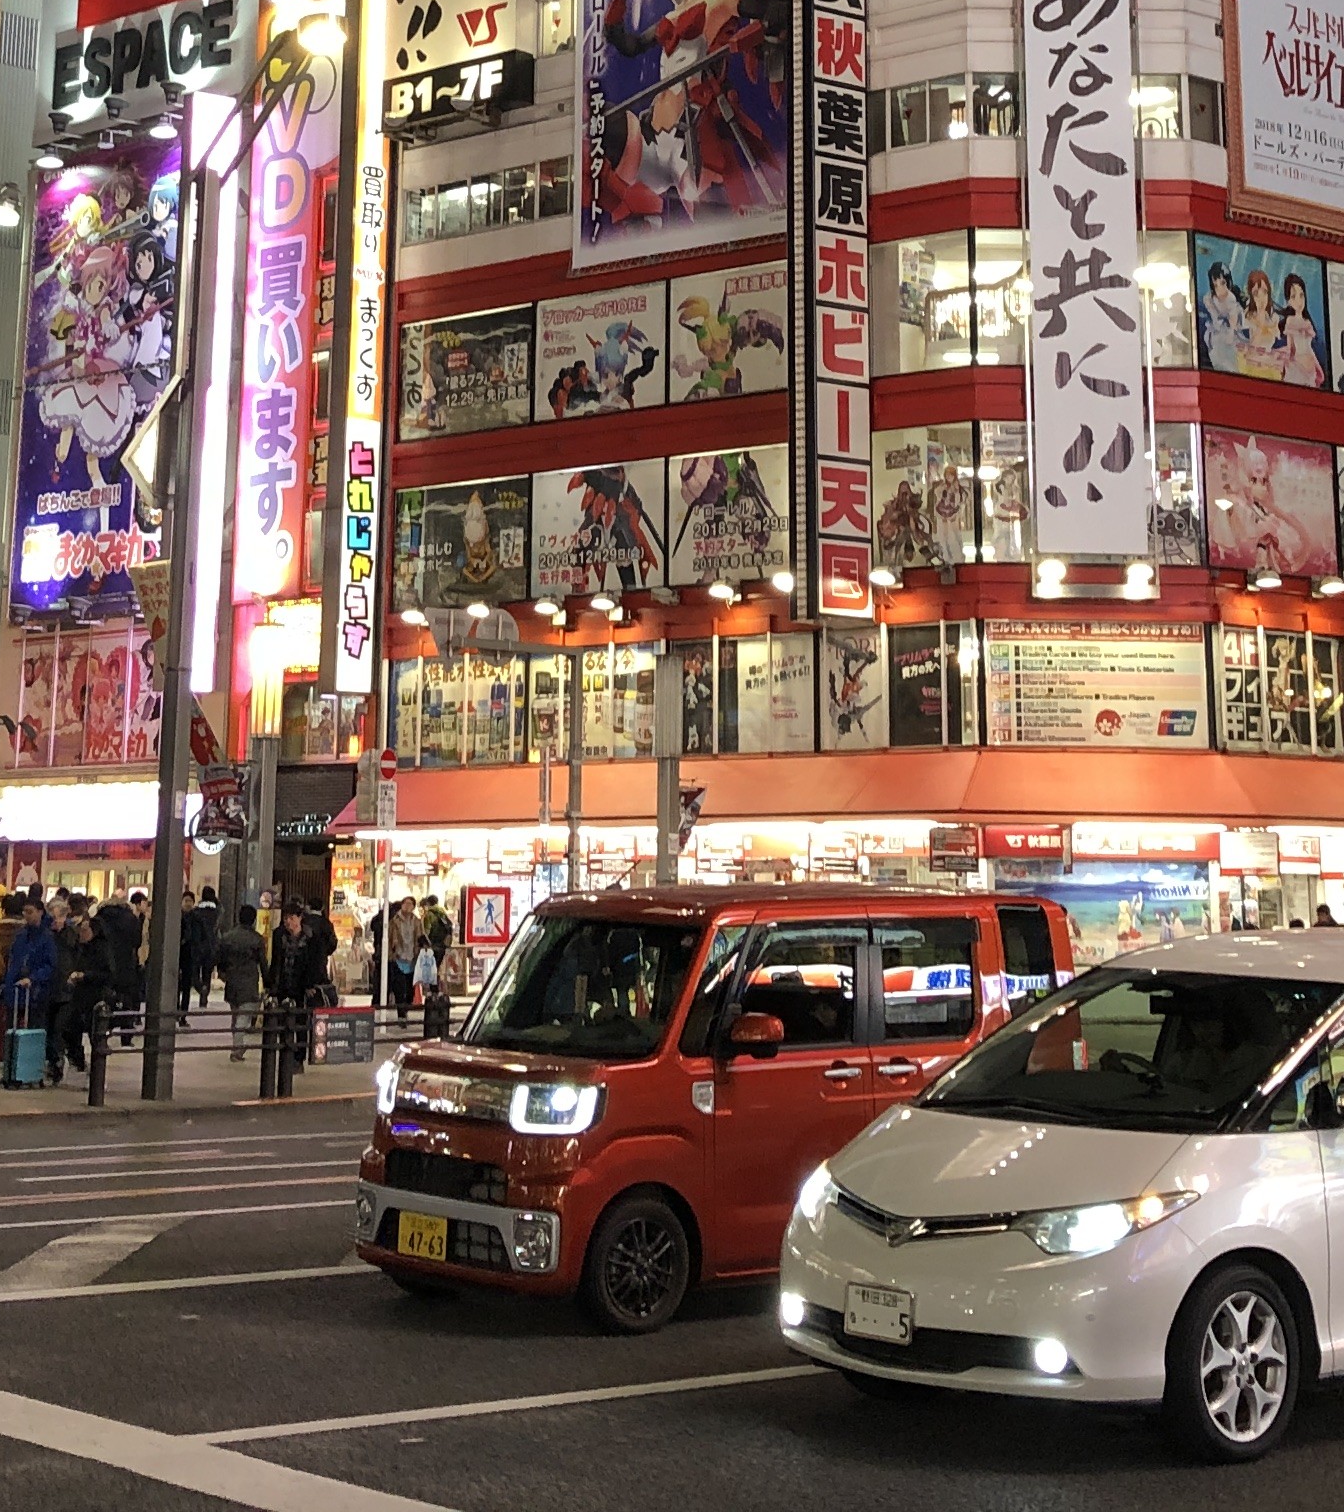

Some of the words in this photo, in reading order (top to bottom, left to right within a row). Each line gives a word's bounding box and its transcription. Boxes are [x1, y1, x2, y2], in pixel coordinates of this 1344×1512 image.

[52, 0, 234, 110] ESPACE
[360, 166, 386, 254] 買取り
[357, 297, 381, 400] まっくす
[344, 441, 376, 659] とれじゃらす
[1223, 632, 1258, 665] 4F
